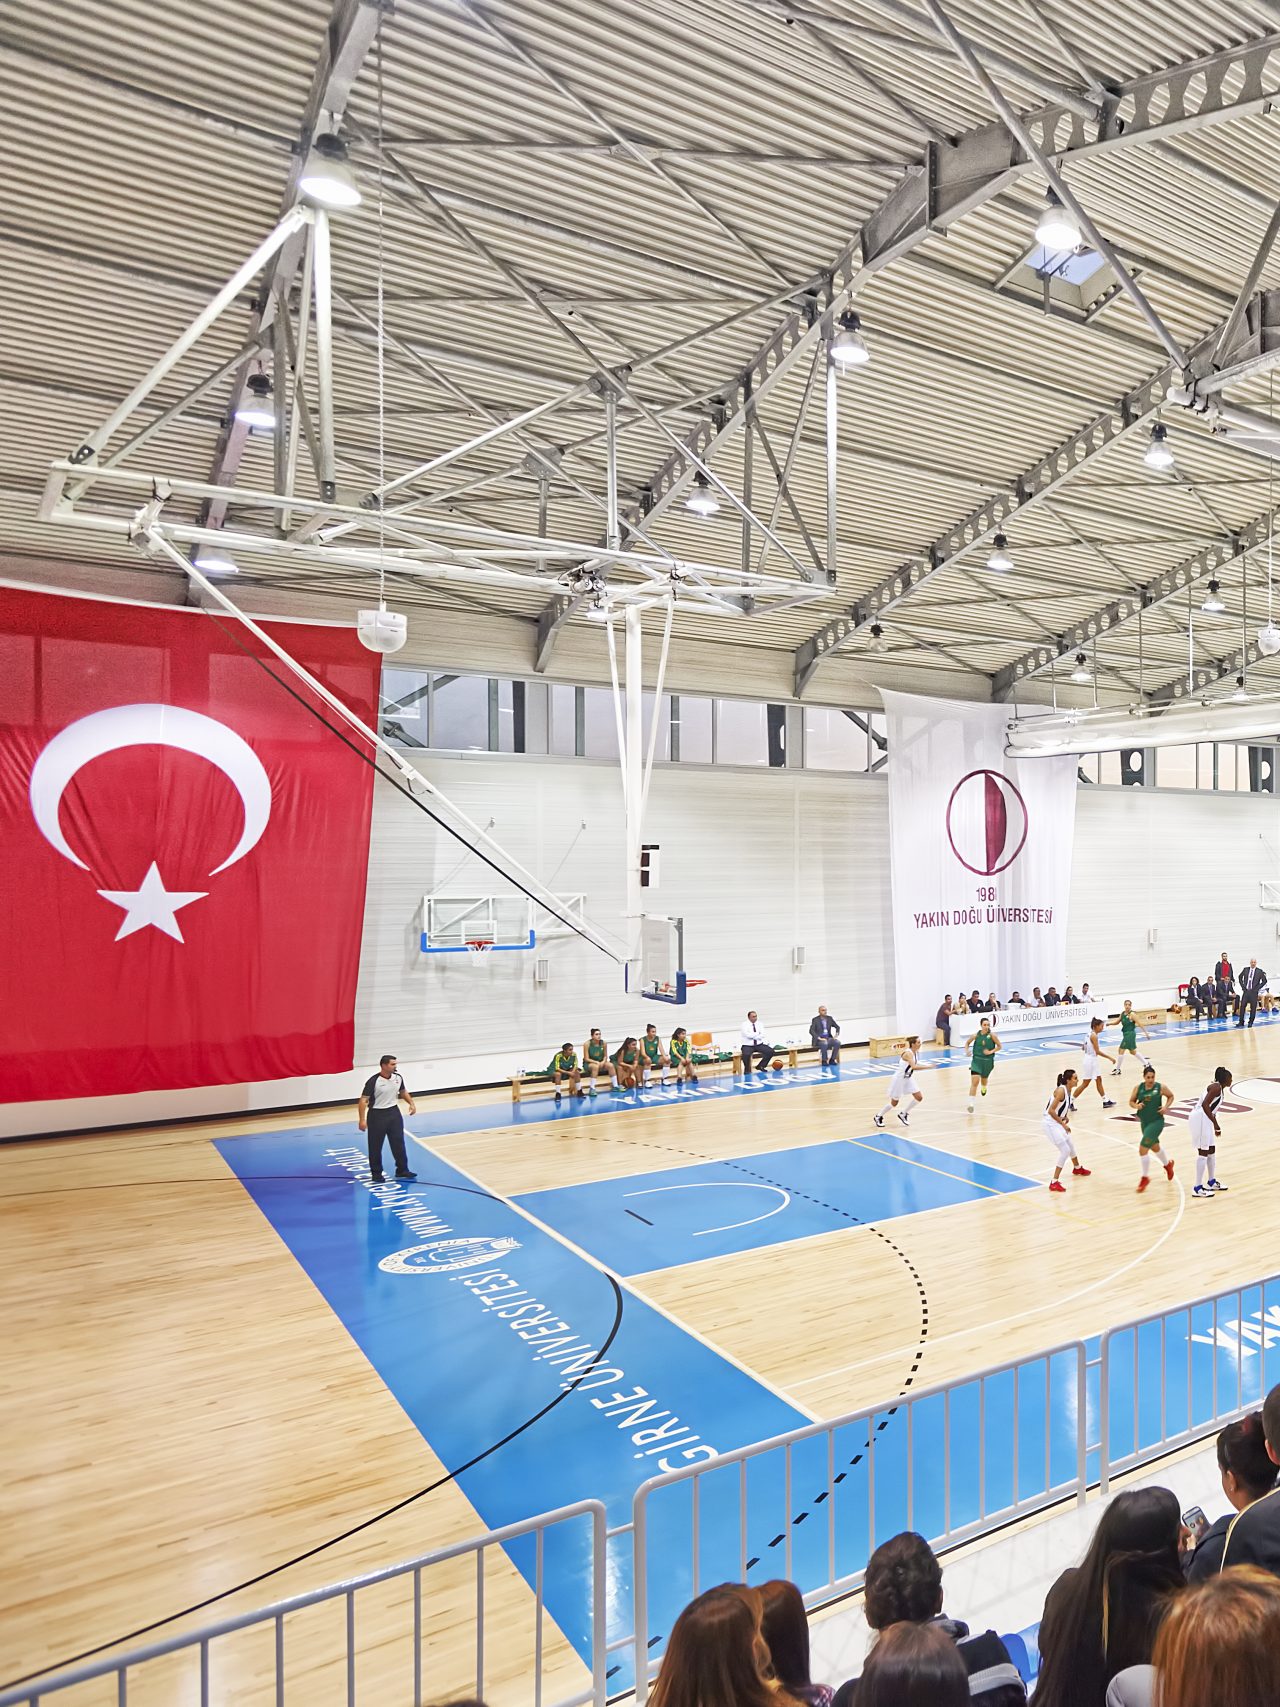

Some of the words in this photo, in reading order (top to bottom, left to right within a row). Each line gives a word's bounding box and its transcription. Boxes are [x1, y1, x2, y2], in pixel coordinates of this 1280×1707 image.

[913, 910, 950, 929] YAKIN
[953, 905, 982, 926] DOĞU
[986, 904, 1053, 924] ÜİVERSİTESİ
[1001, 1014, 1020, 1024] YAKIN
[1022, 1011, 1042, 1022] DOĞU
[610, 1085, 730, 1106] YAKIN
[449, 1267, 625, 1392] ÜNİVERSİTESİ
[589, 1386, 720, 1475] GİRNE
